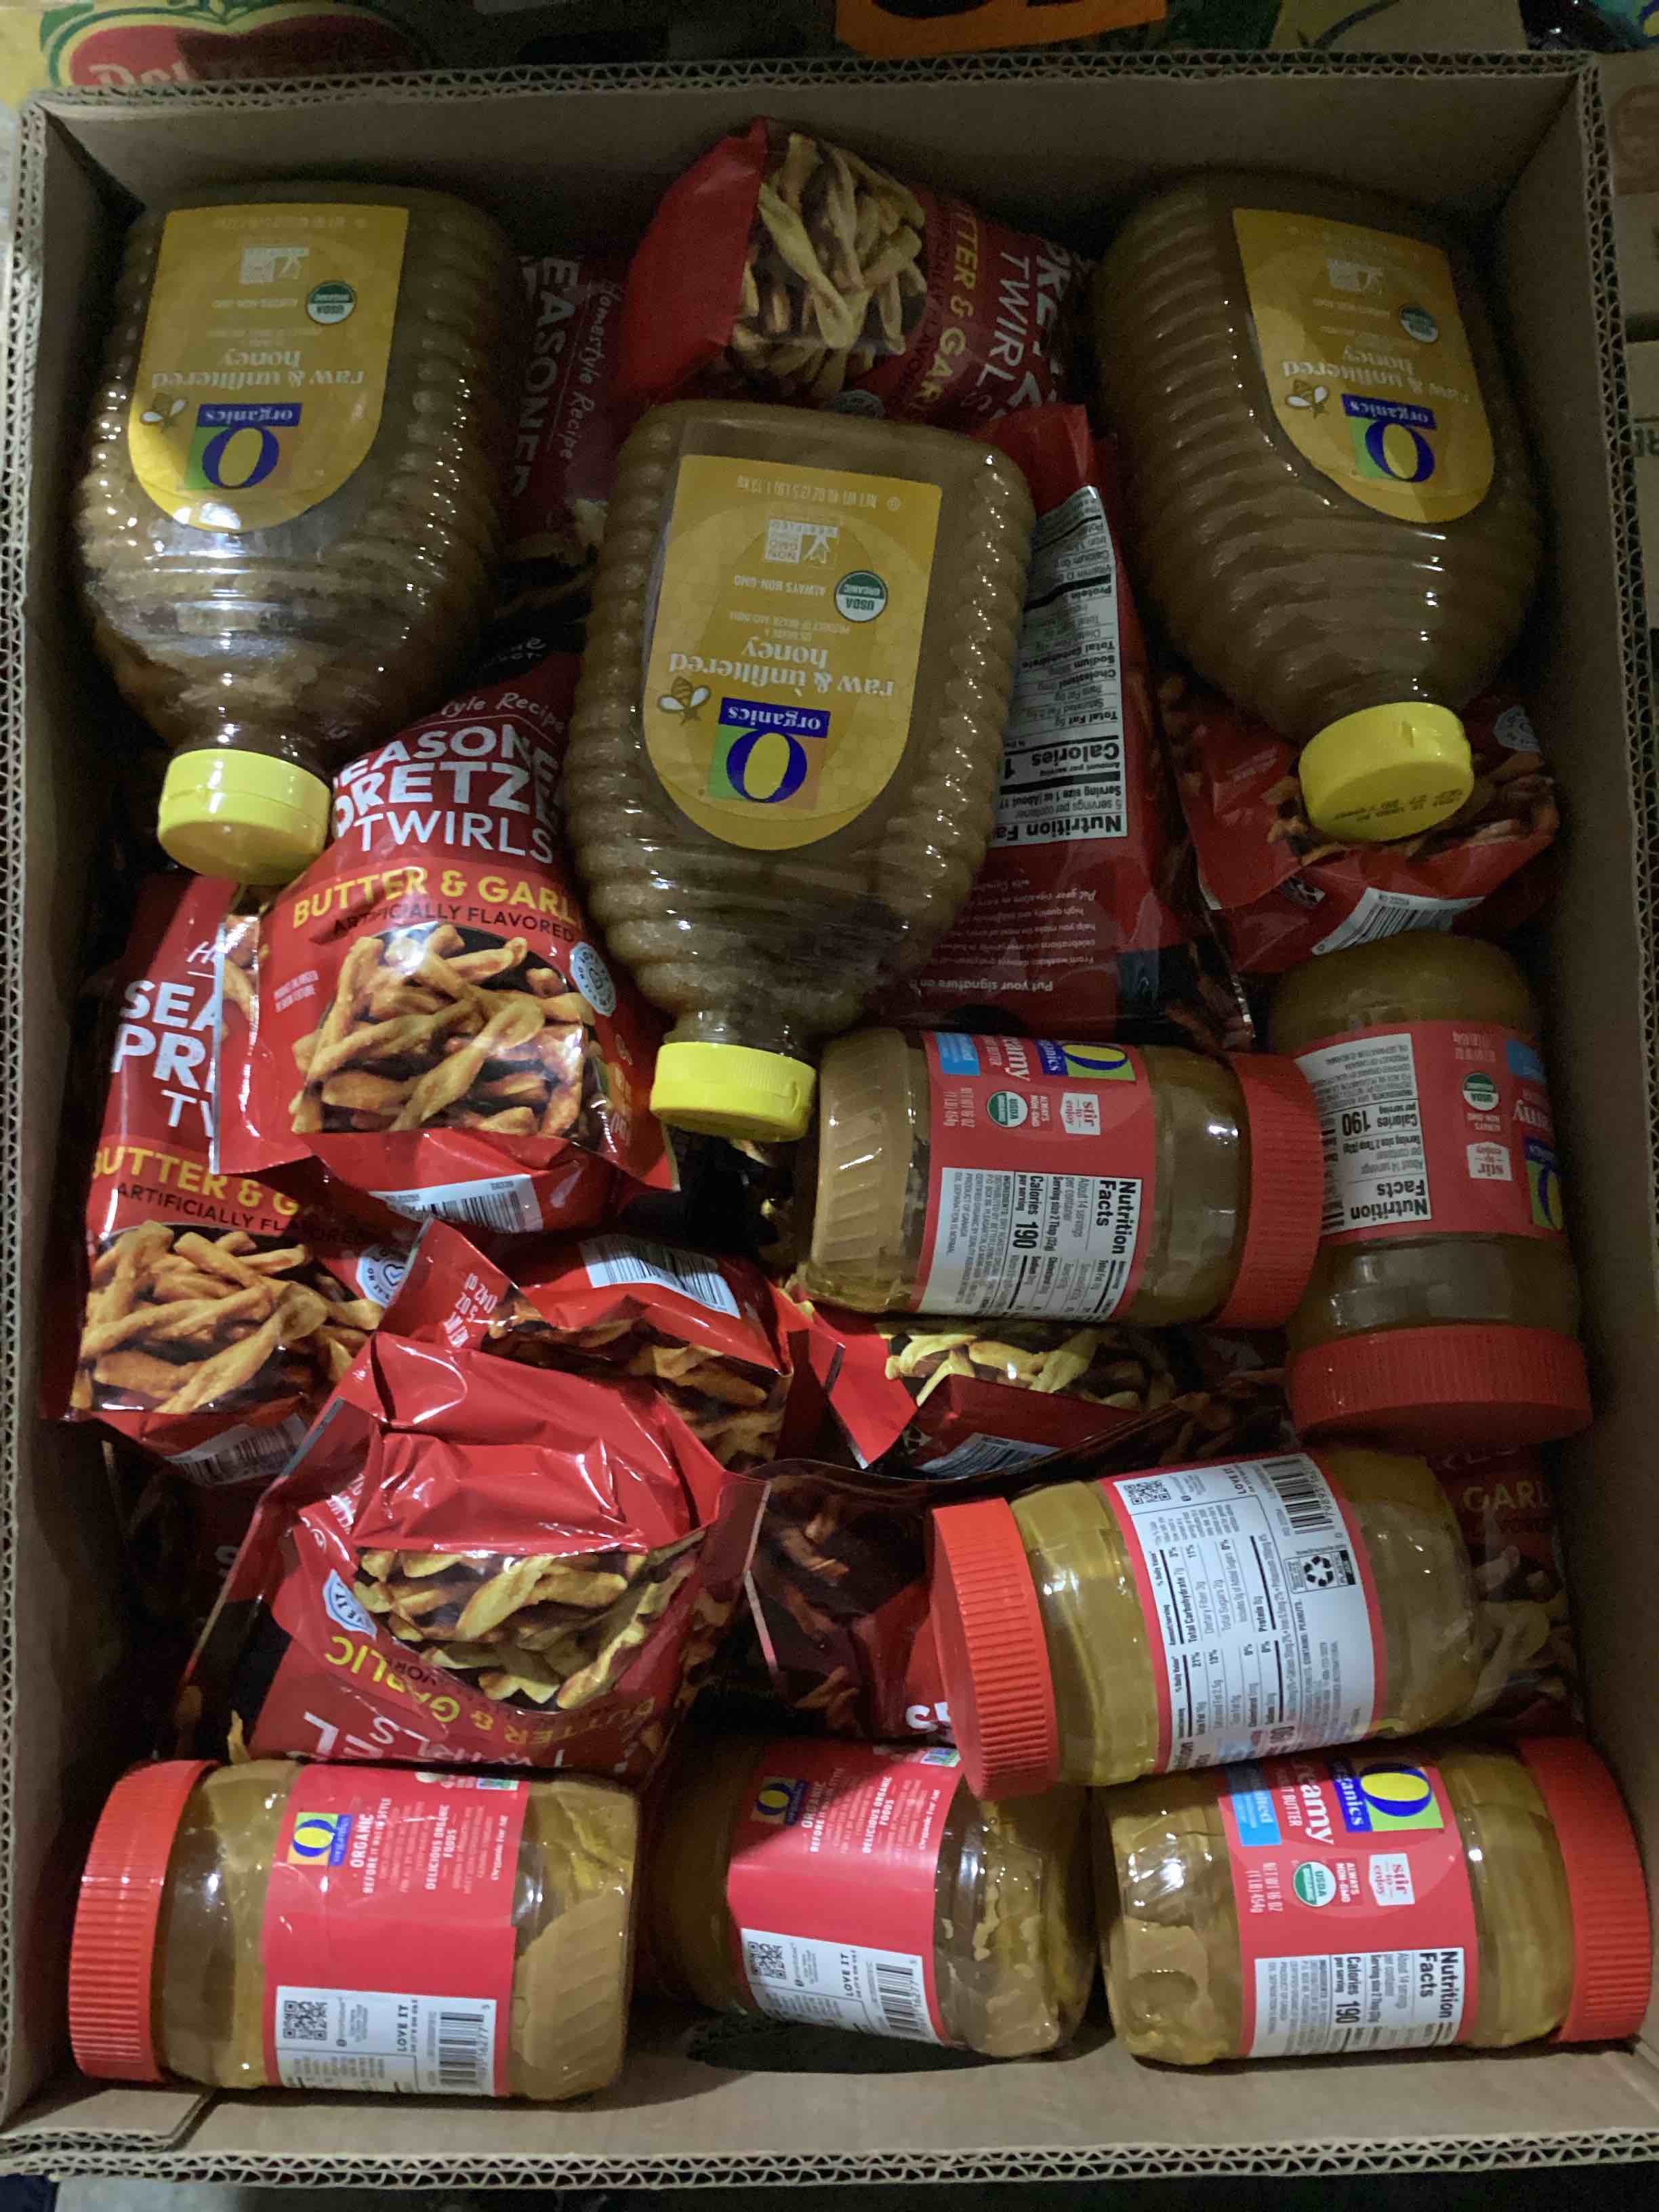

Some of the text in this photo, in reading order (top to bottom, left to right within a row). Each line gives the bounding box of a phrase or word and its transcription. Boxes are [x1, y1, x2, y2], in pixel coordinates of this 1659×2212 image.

[218, 348, 301, 369] honey
[1344, 346, 1413, 377] honey
[151, 370, 364, 390] raw & unfiltered
[1283, 361, 1400, 388] unfiltered
[1404, 377, 1422, 394] &
[205, 407, 293, 425] organics
[556, 392, 596, 461] Recipe
[1349, 401, 1430, 424] organics
[203, 425, 279, 489] O
[1365, 422, 1435, 483] O
[785, 581, 826, 597] ALWAYS
[842, 584, 880, 596] ORGANIC
[845, 598, 875, 611] USDA
[741, 636, 829, 670] honey
[1073, 655, 1115, 668] Sodium
[1085, 641, 1115, 652] Total
[668, 653, 895, 697] raw & unfiltered
[728, 706, 821, 731] organics
[1089, 712, 1118, 722] Total
[725, 731, 808, 804] O
[1031, 742, 1120, 767] Calories
[1063, 785, 1122, 799] Serving size
[352, 809, 554, 864] TWIRLS
[1026, 815, 1122, 838] Nutrition
[292, 865, 428, 928] BUTTER
[440, 869, 468, 898] &
[467, 906, 576, 943] FLAVORED
[938, 978, 1054, 992] Put your signature
[1008, 1098, 1019, 1120] USDA
[1063, 1099, 1075, 1126] enjoy
[1082, 1101, 1098, 1128] stir
[1342, 1111, 1418, 1136] Calories 190
[1477, 1163, 1504, 1176] stir
[238, 1179, 262, 1207] &
[962, 1172, 972, 1202] PRODUCT
[1015, 1174, 1028, 1212] per serving
[1049, 1176, 1064, 1201] Serving
[1376, 1179, 1426, 1197] Facts
[117, 1182, 256, 1228] ARTIFICIALLY
[1012, 1175, 1044, 1250] Calories 190
[1050, 1201, 1061, 1214] size
[1063, 1189, 1076, 1222] container
[1071, 1177, 1091, 1238] About 14 servings
[1097, 1179, 1117, 1227] Facts
[1111, 1181, 1136, 1255] Nutrition
[1349, 1198, 1429, 1221] Nutrition
[1176, 1576, 1197, 1643] Total Carbohydrate
[1256, 1605, 1269, 1632] Protein
[1191, 1652, 1202, 1668] 21%
[324, 1635, 460, 1723] GARLIC
[800, 1780, 825, 1828] ORGANIC
[1358, 1763, 1433, 1818] O
[861, 1776, 893, 1854] DELICIOUS ORGANIC
[878, 1799, 895, 1826] FOODS
[1280, 1794, 1302, 1827] BUTTER
[292, 1819, 335, 1858] O
[349, 1814, 375, 1868] ORGANIC
[424, 1804, 450, 1891] DELICIOUS ORGANIC
[444, 1828, 457, 1858] FOODS
[809, 1819, 825, 1853] BEFORE
[361, 1856, 379, 1894] BEFORE
[1263, 1862, 1278, 1877] NET
[1264, 1878, 1279, 1889] WT
[1315, 1870, 1327, 1898] USDA
[1335, 1862, 1351, 1904] NON-GMO
[1346, 1862, 1361, 1895] ALWAYS
[1374, 1865, 1387, 1895] enjoy
[1392, 1864, 1409, 1894] stir
[1248, 1893, 1265, 1914] 454g
[1268, 1901, 1283, 1912] OZ
[840, 1952, 854, 1997] LOVE IT
[1334, 1957, 1346, 1993] per serving
[1369, 1954, 1382, 1979] Serving
[1397, 1952, 1410, 1974] About
[1420, 1952, 1437, 1999] Facts
[1334, 1956, 1362, 2024] Calories 190
[1438, 1951, 1459, 2019] Nutrition
[396, 2004, 408, 2053] LOVE IT
